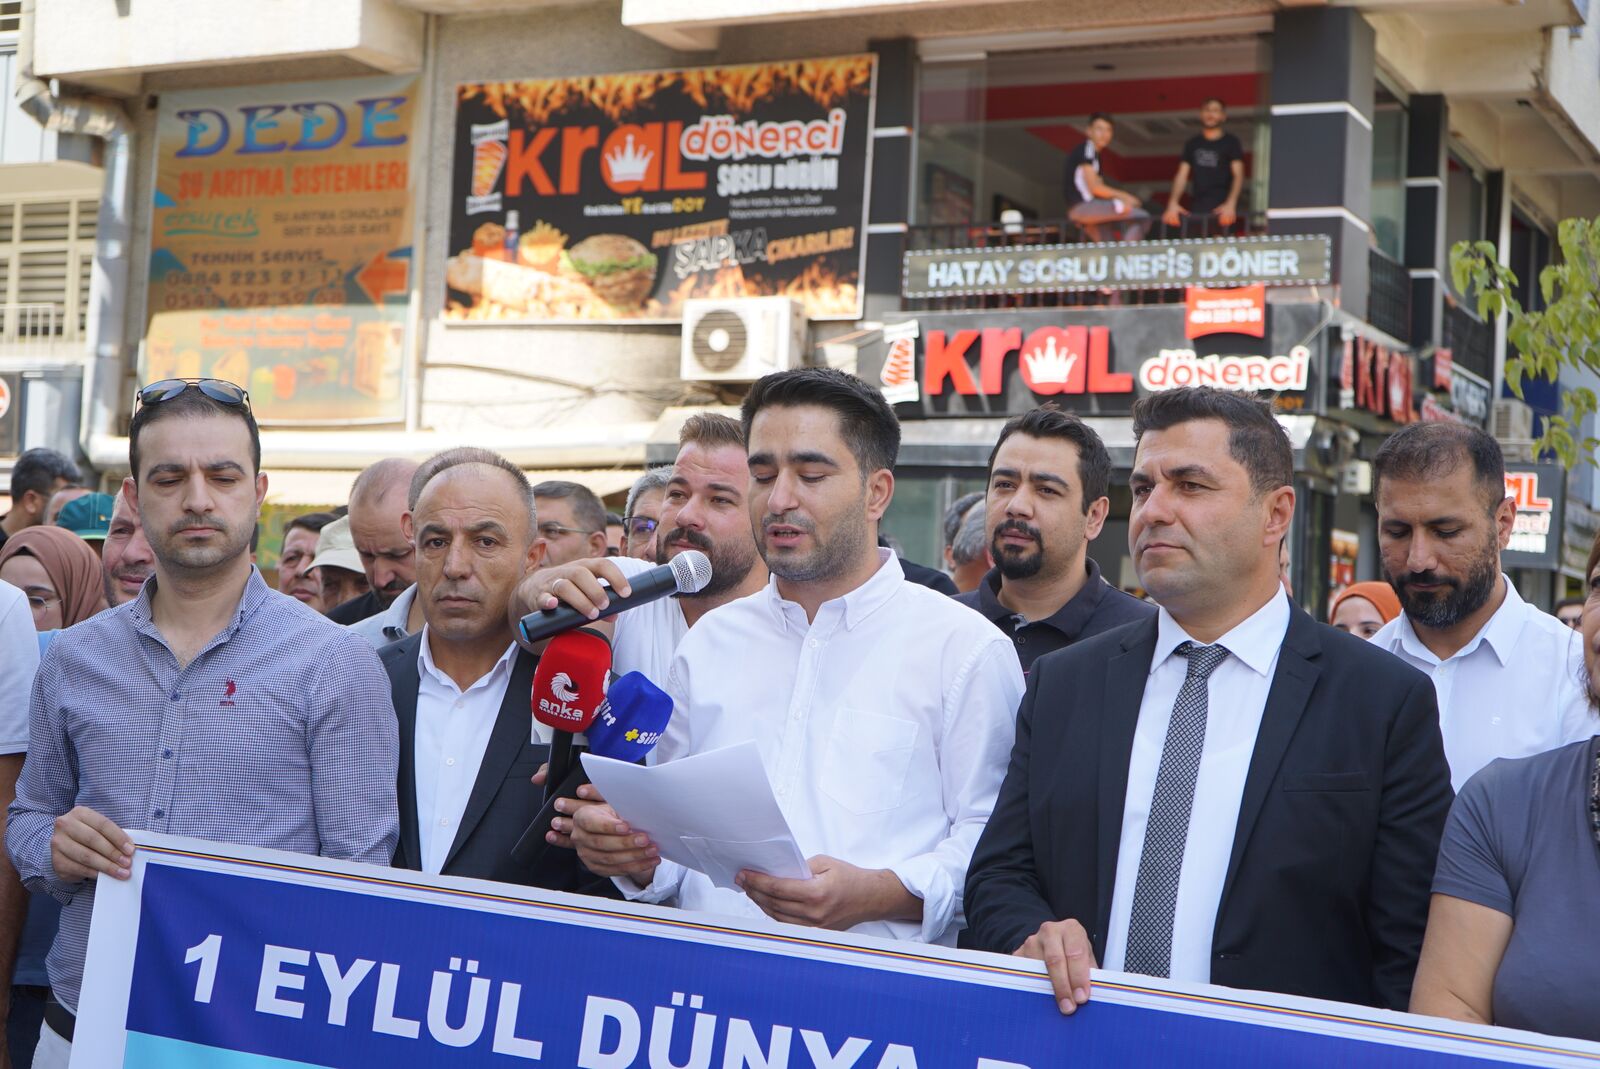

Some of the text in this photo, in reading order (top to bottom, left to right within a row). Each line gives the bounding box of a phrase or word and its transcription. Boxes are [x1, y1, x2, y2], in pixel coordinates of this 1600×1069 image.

[176, 97, 408, 158] DEDE
[178, 173, 204, 200] SU
[208, 166, 285, 199] ARITMA
[928, 246, 1300, 288] HATAY SOSLU NEFİS DÖNER
[539, 698, 584, 718] anka
[184, 933, 223, 1004] 1
[255, 943, 543, 1061] EYLÜL
